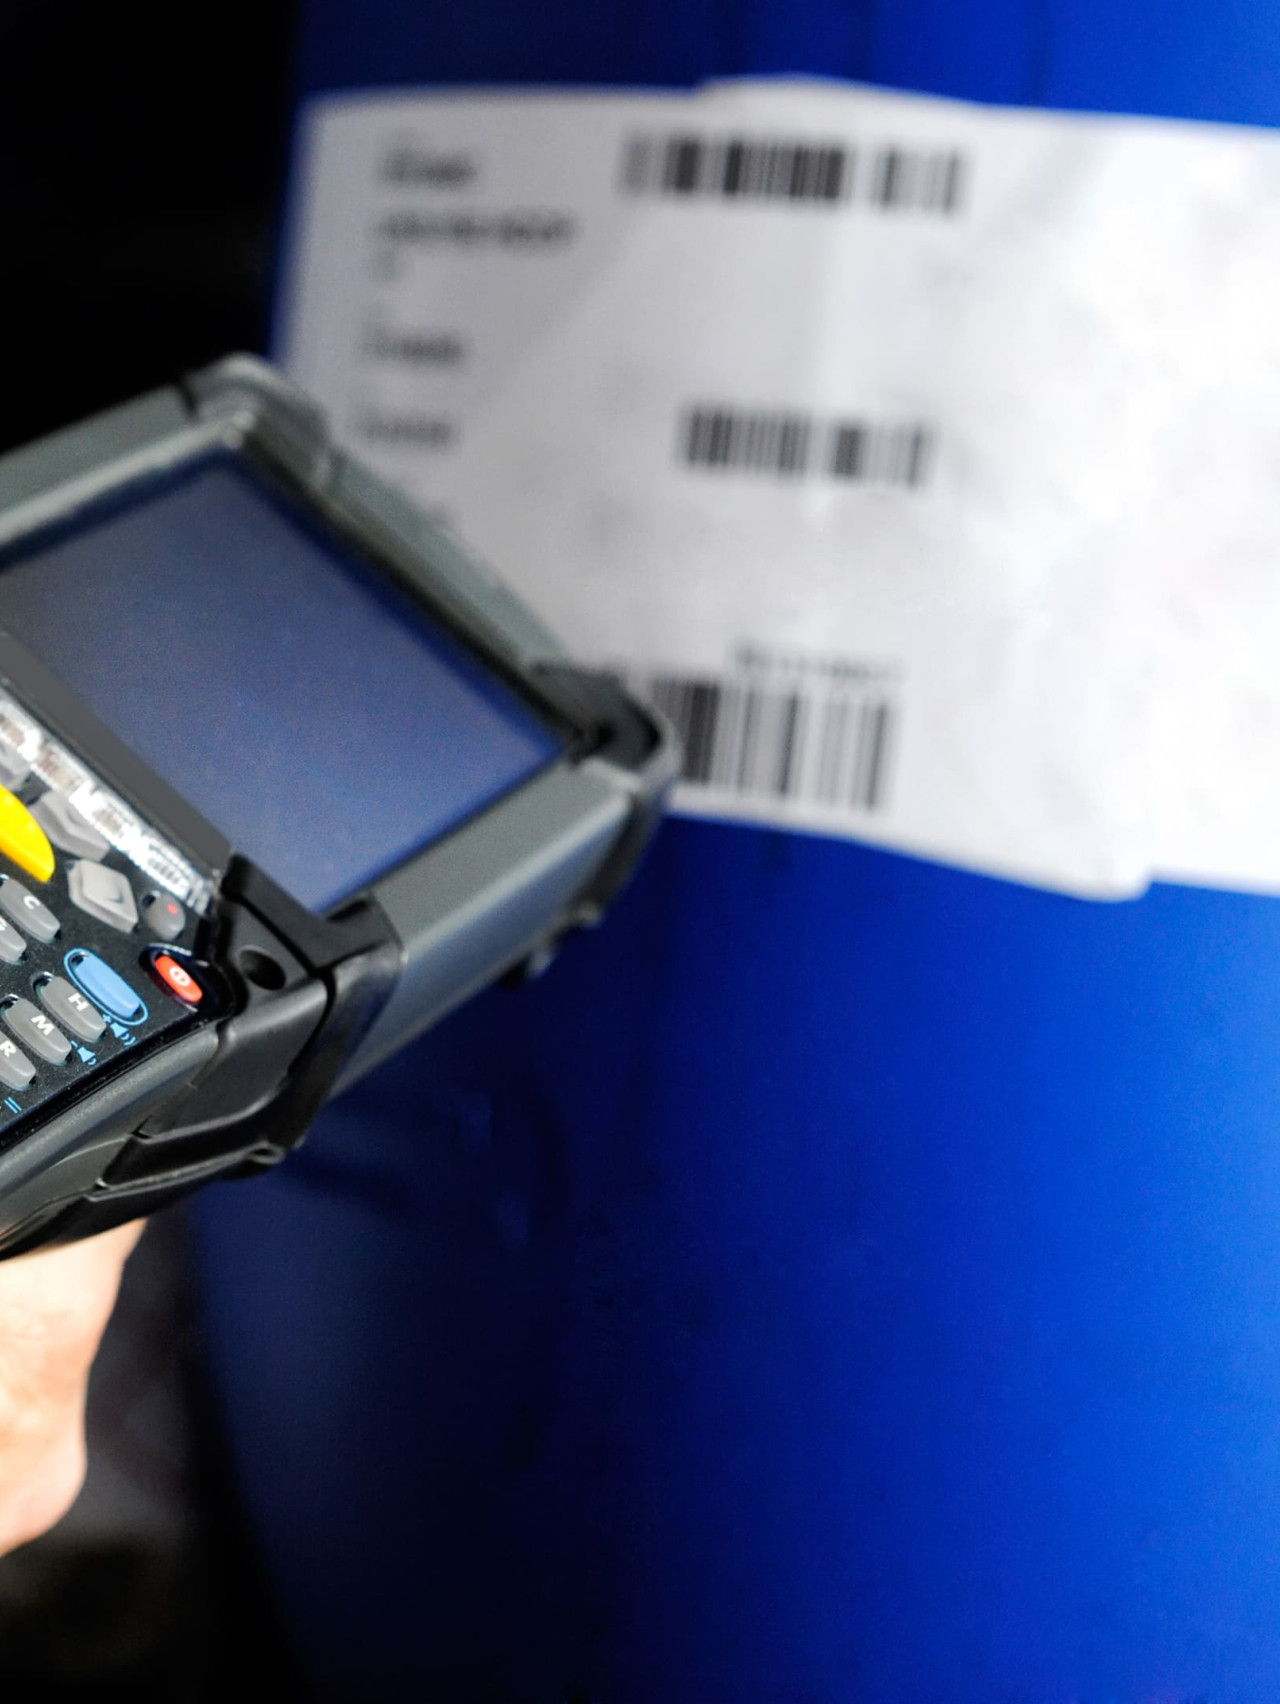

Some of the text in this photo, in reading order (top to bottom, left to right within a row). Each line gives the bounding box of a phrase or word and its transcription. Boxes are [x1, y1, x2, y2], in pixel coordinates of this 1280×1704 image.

[23, 895, 40, 909] C
[68, 993, 89, 1012] H
[31, 1014, 54, 1036] M
